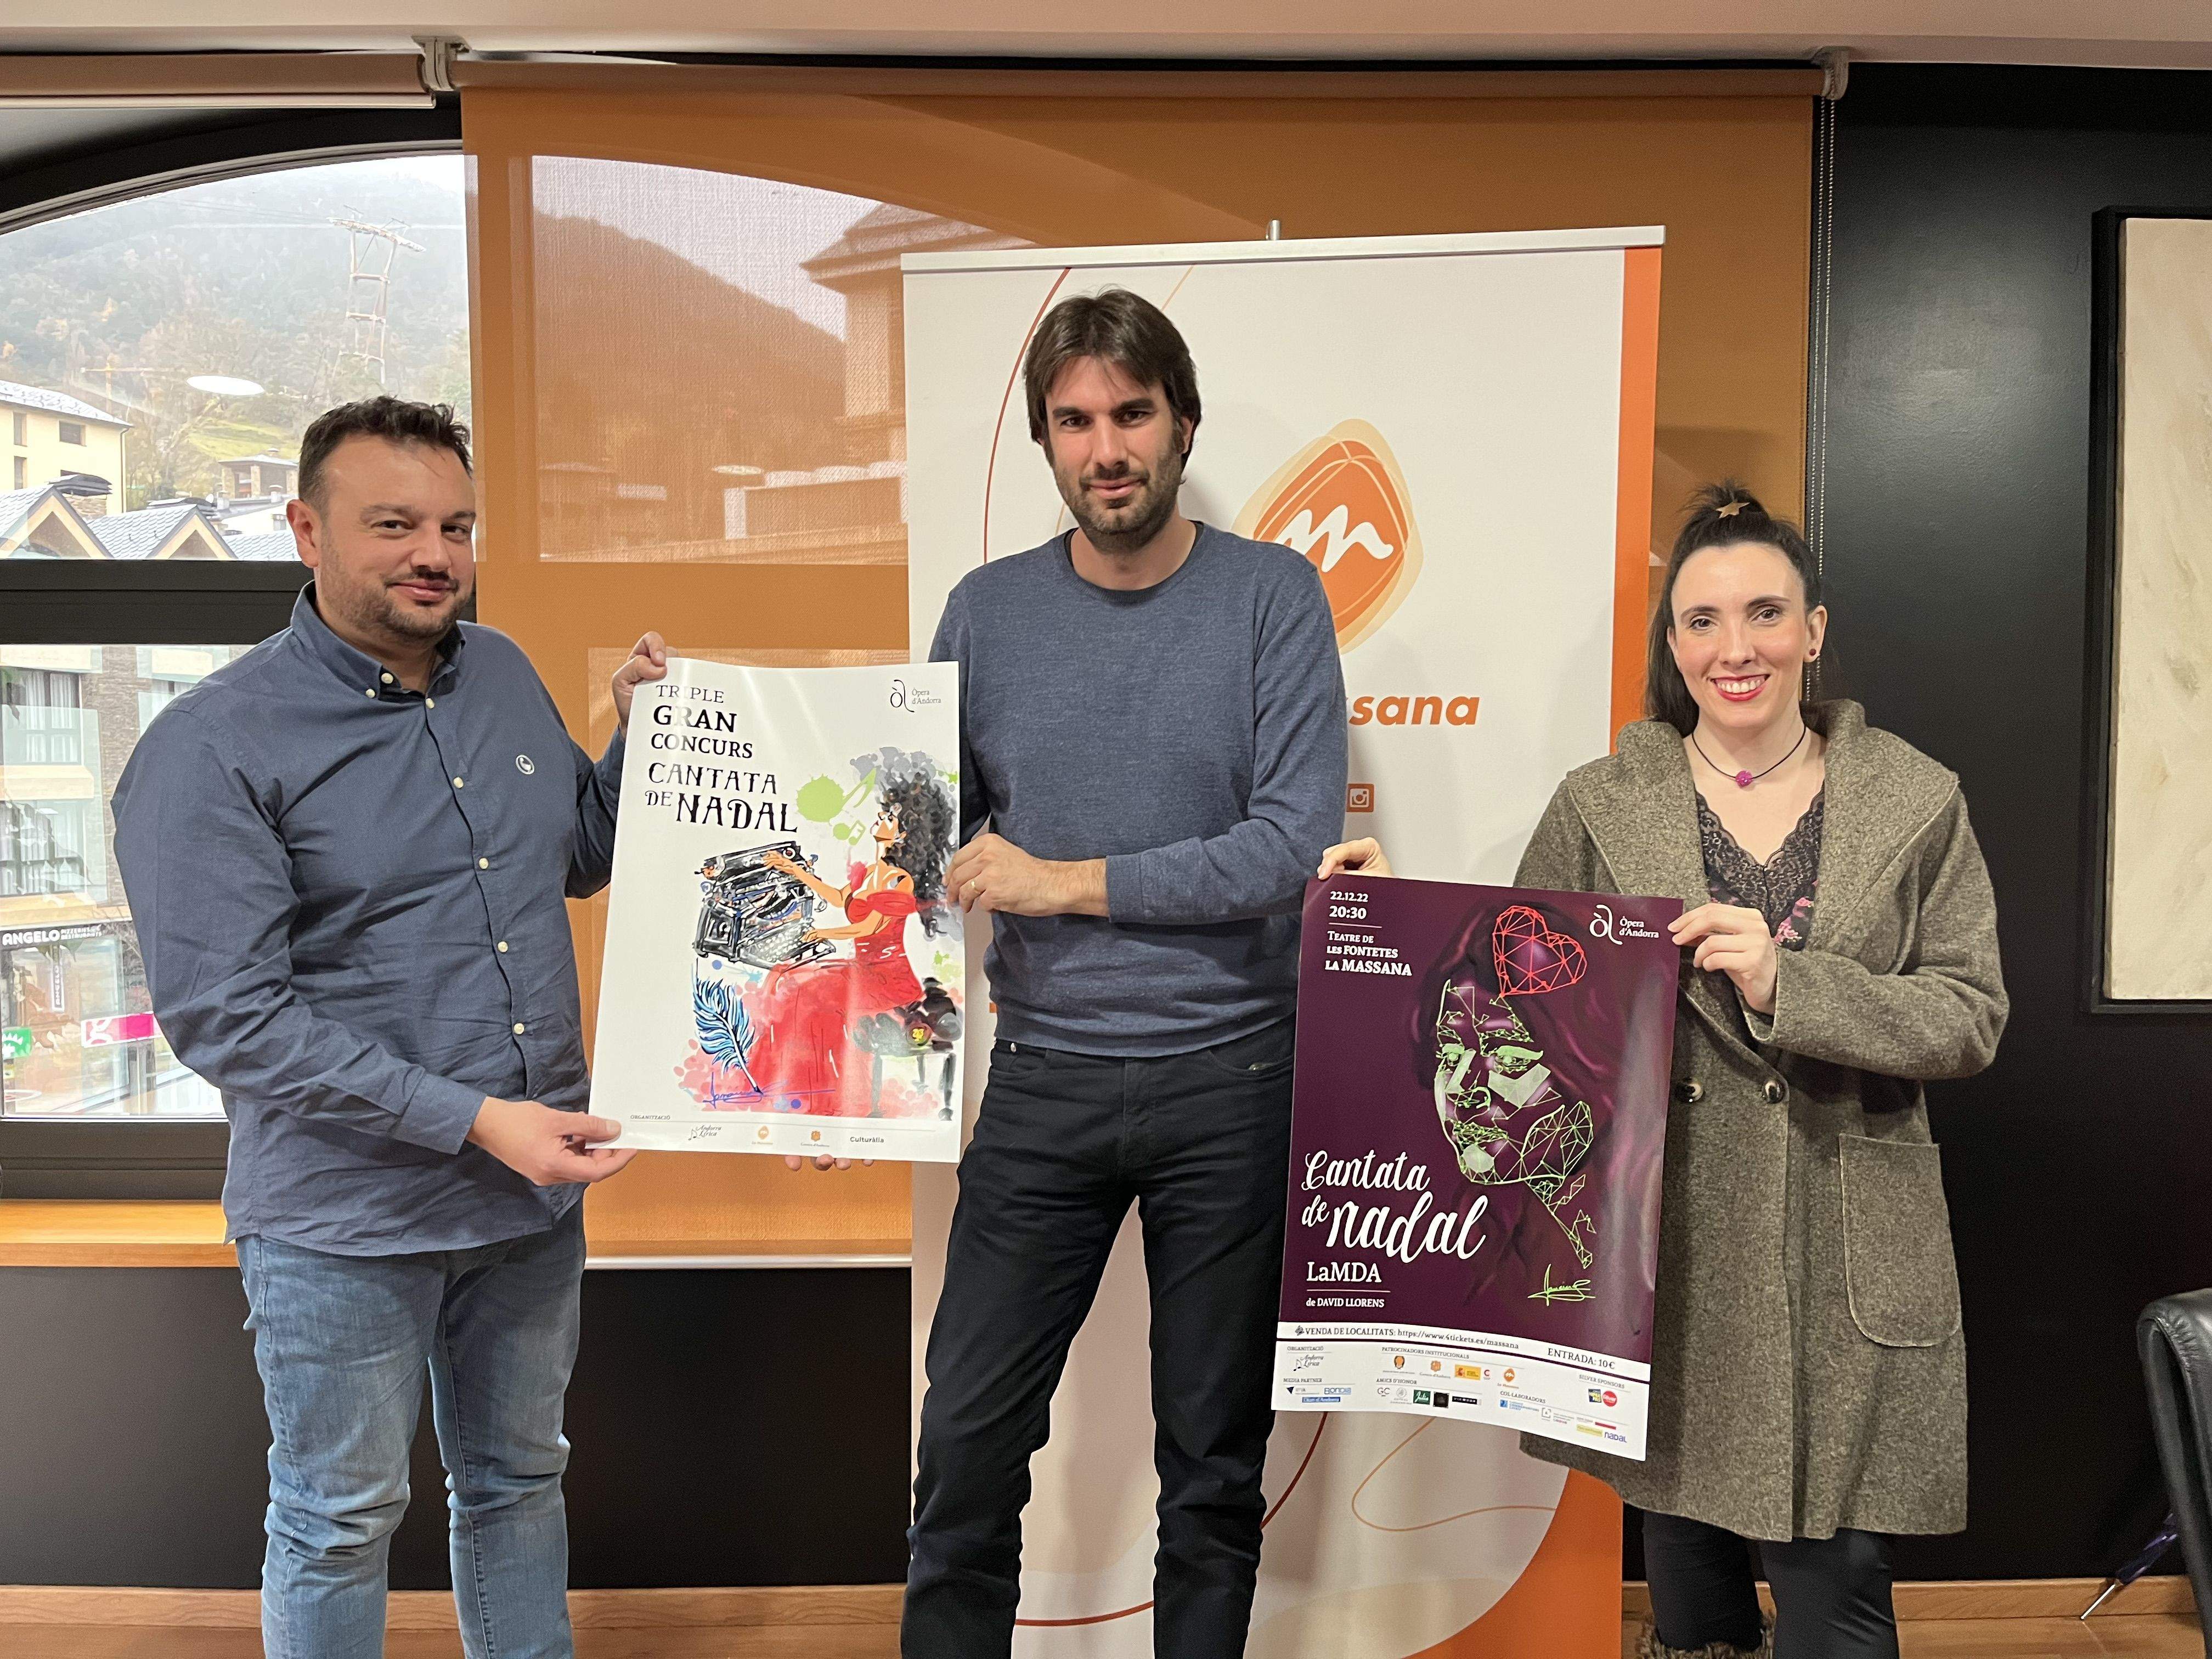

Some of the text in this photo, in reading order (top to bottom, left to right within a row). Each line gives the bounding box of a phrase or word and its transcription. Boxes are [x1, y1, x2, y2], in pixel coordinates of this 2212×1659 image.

[656, 685, 724, 703] TRPLE
[653, 705, 737, 733] GRAN
[1346, 696, 1480, 726] sana
[651, 733, 753, 759] CONCURS
[648, 762, 777, 795] CANTATA
[645, 790, 798, 833] DE NADAL
[1330, 890, 1368, 902] 22.12.22
[1329, 905, 1367, 919] 20:30
[1620, 916, 1644, 928] Òpera
[2, 929, 60, 946] ANGELO
[1363, 935, 1374, 944] DE
[1619, 928, 1659, 938] d'Andorra
[1327, 945, 1398, 958] LES FONTETES
[1325, 958, 1413, 976] LA MASSANA
[1301, 1149, 1431, 1191] Cantata
[1302, 1191, 1488, 1263] de nadal
[1306, 1261, 1382, 1283] LaMDA
[1306, 1298, 1385, 1308] de DAVID LLORENS
[1305, 1327, 1332, 1335] VENDA
[1346, 1328, 1396, 1336] LOCALITATS:
[1548, 1348, 1616, 1370] ENTRADA: 10€
